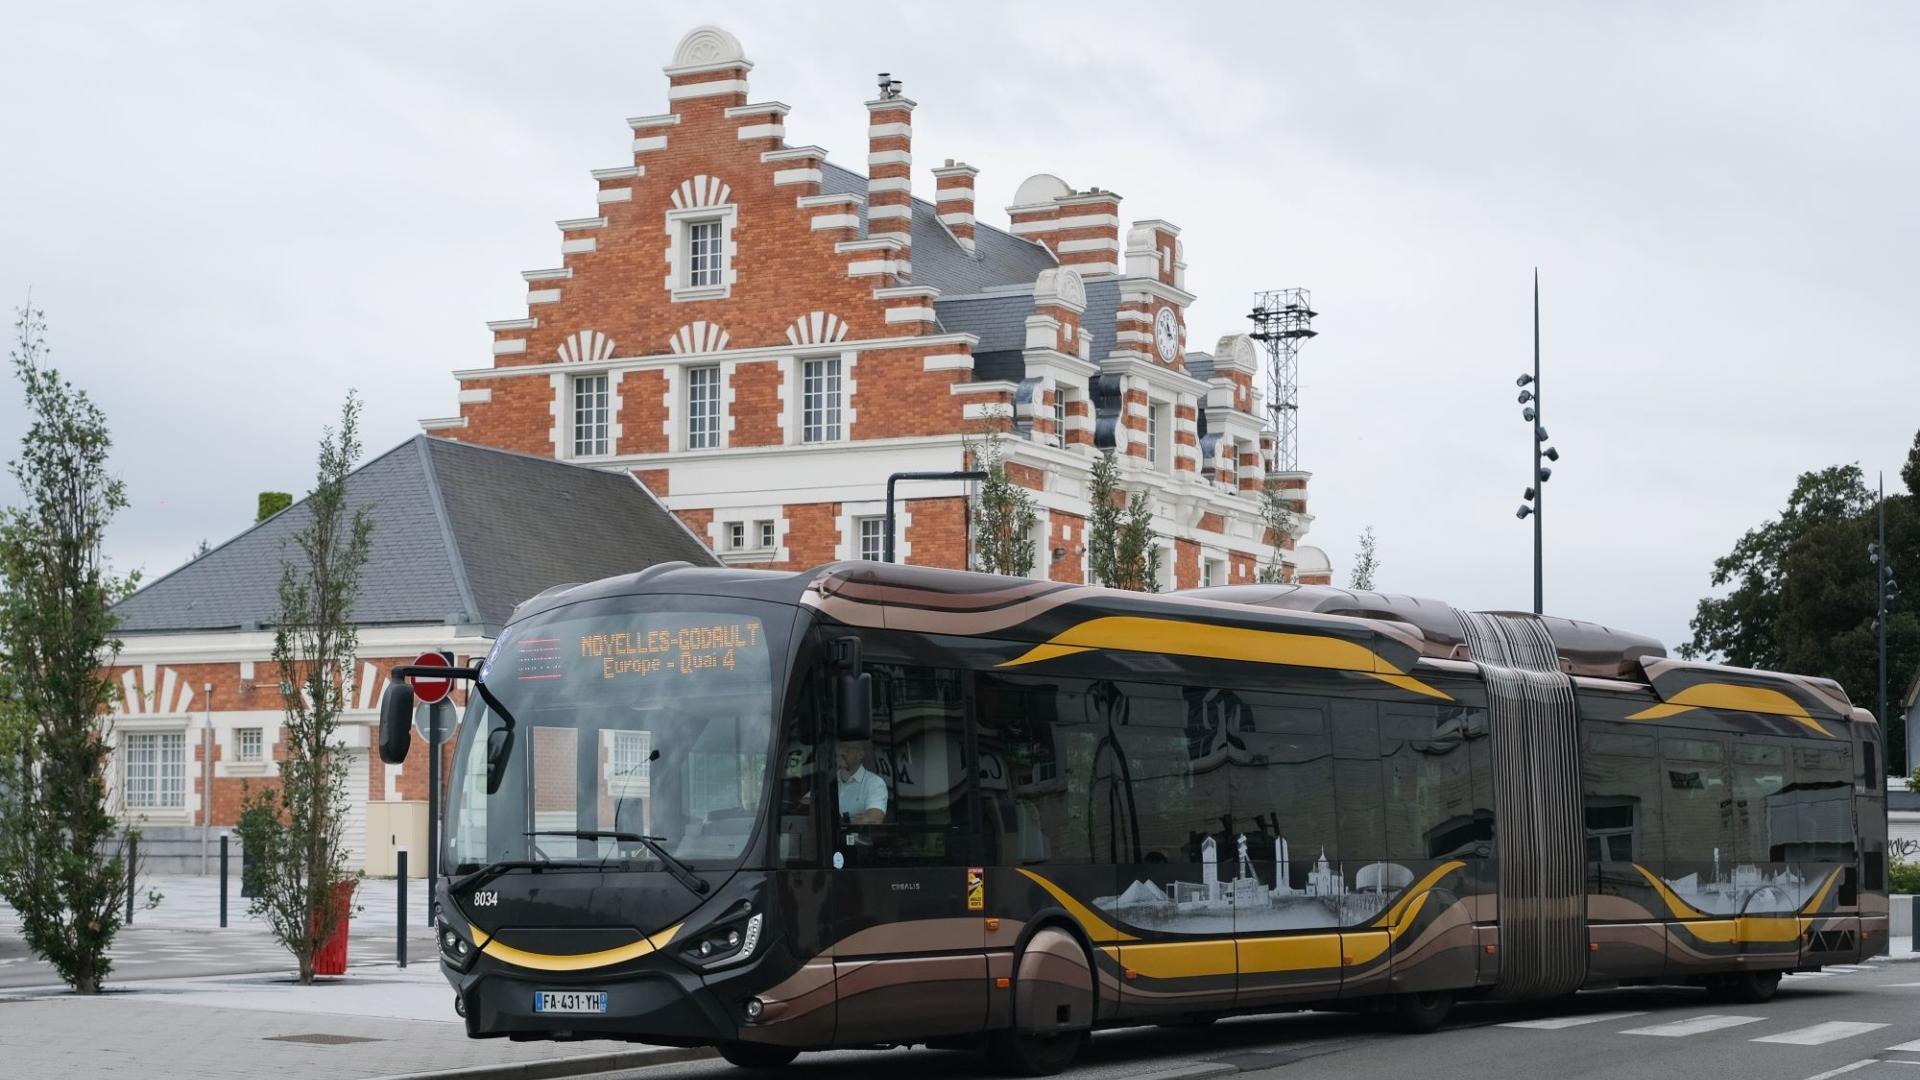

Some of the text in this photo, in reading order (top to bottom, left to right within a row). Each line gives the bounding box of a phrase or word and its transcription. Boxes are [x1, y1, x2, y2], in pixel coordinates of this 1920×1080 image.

[581, 623, 760, 657] NOYELLES-GODAULT
[603, 657, 661, 679] Europe
[679, 650, 717, 674] Quai
[723, 649, 736, 671] 4
[474, 891, 498, 906] 8034
[543, 994, 599, 1010] FA-431-YH
